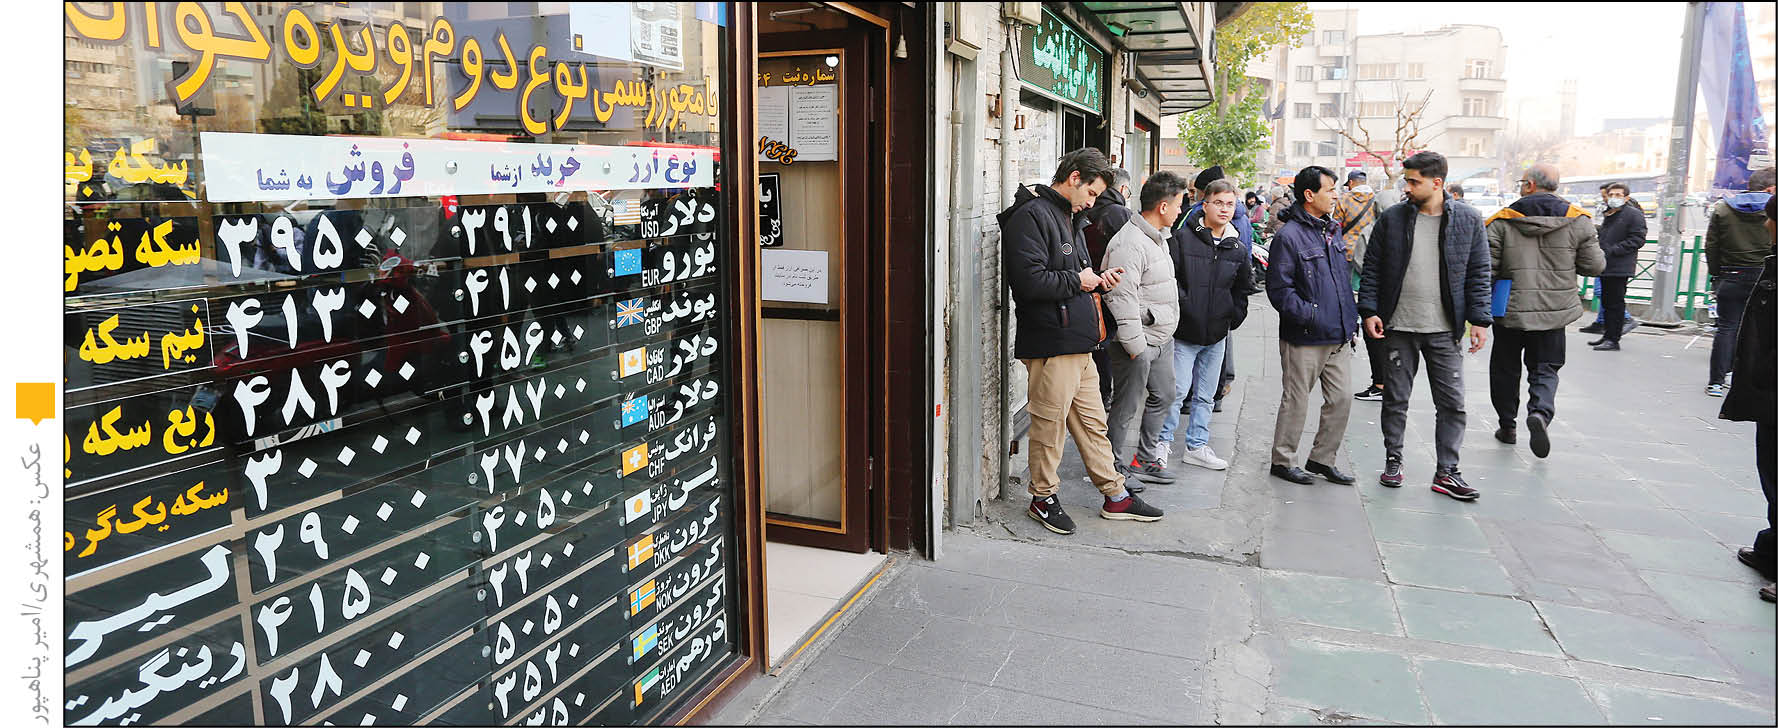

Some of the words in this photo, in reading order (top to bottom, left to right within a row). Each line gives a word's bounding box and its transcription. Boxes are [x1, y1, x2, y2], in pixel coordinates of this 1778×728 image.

[425, 18, 519, 111] دوم
[521, 36, 589, 135] نوع
[783, 67, 801, 87] ثبت
[803, 67, 836, 86] شماره
[593, 79, 655, 129] رسمی
[108, 137, 189, 185] سکه
[256, 168, 291, 190] شما
[296, 174, 313, 196] به
[326, 142, 415, 195] فروش
[531, 147, 581, 187] خرید
[628, 150, 659, 183] ارز
[665, 152, 697, 183] نوع
[461, 205, 579, 255] ۳۹۱۰۰
[641, 220, 659, 238] USD
[660, 198, 716, 237] دلار
[135, 219, 201, 267] سکه
[217, 213, 407, 278] ۳۹۵۰۰
[660, 241, 716, 284] یورو
[465, 266, 582, 316] ۴۱۰۰۰
[642, 268, 661, 288] EUR
[226, 287, 410, 360] ۴۱۳۰۰
[644, 317, 662, 336] GBP
[661, 291, 716, 323] پوند
[79, 313, 150, 364] سکه
[161, 304, 205, 369] نیم
[469, 321, 585, 378] ۴۵۶۰۰
[664, 334, 718, 379] دلار
[233, 359, 416, 436] ۴۸۴۰۰
[646, 365, 664, 384] CAD
[475, 377, 587, 436] ۲۸۷۰۰
[648, 410, 666, 433] AUD
[665, 379, 719, 424] دلار
[83, 405, 152, 456] سکه
[163, 405, 215, 455] ربع
[665, 415, 717, 461] فرانک
[244, 426, 422, 511] ۳۰۰۰۰
[480, 429, 590, 494] ۲۷۰۰۰
[648, 456, 665, 478] CHF
[668, 455, 720, 511] ین
[115, 496, 171, 532] یک
[170, 480, 229, 516] سکه
[482, 480, 594, 552] ۴۰۵۰۰
[651, 501, 668, 523] JPY
[254, 489, 427, 584] ۲۹۰۰۰
[670, 495, 721, 553] کرون
[489, 542, 575, 608] ۲۲۰۰
[653, 545, 671, 569] DKK
[672, 536, 722, 598] کرون
[257, 551, 431, 657] ۴۱۵۰۰
[656, 588, 673, 613] NOK
[674, 573, 724, 640] کرون
[495, 593, 579, 665] ۵۰۵۰
[657, 632, 674, 656] SEK
[675, 619, 725, 683] درهم
[270, 631, 405, 726] ۲۸۰۰
[495, 642, 581, 719] ۳۵۲۰
[660, 675, 677, 699] AED
